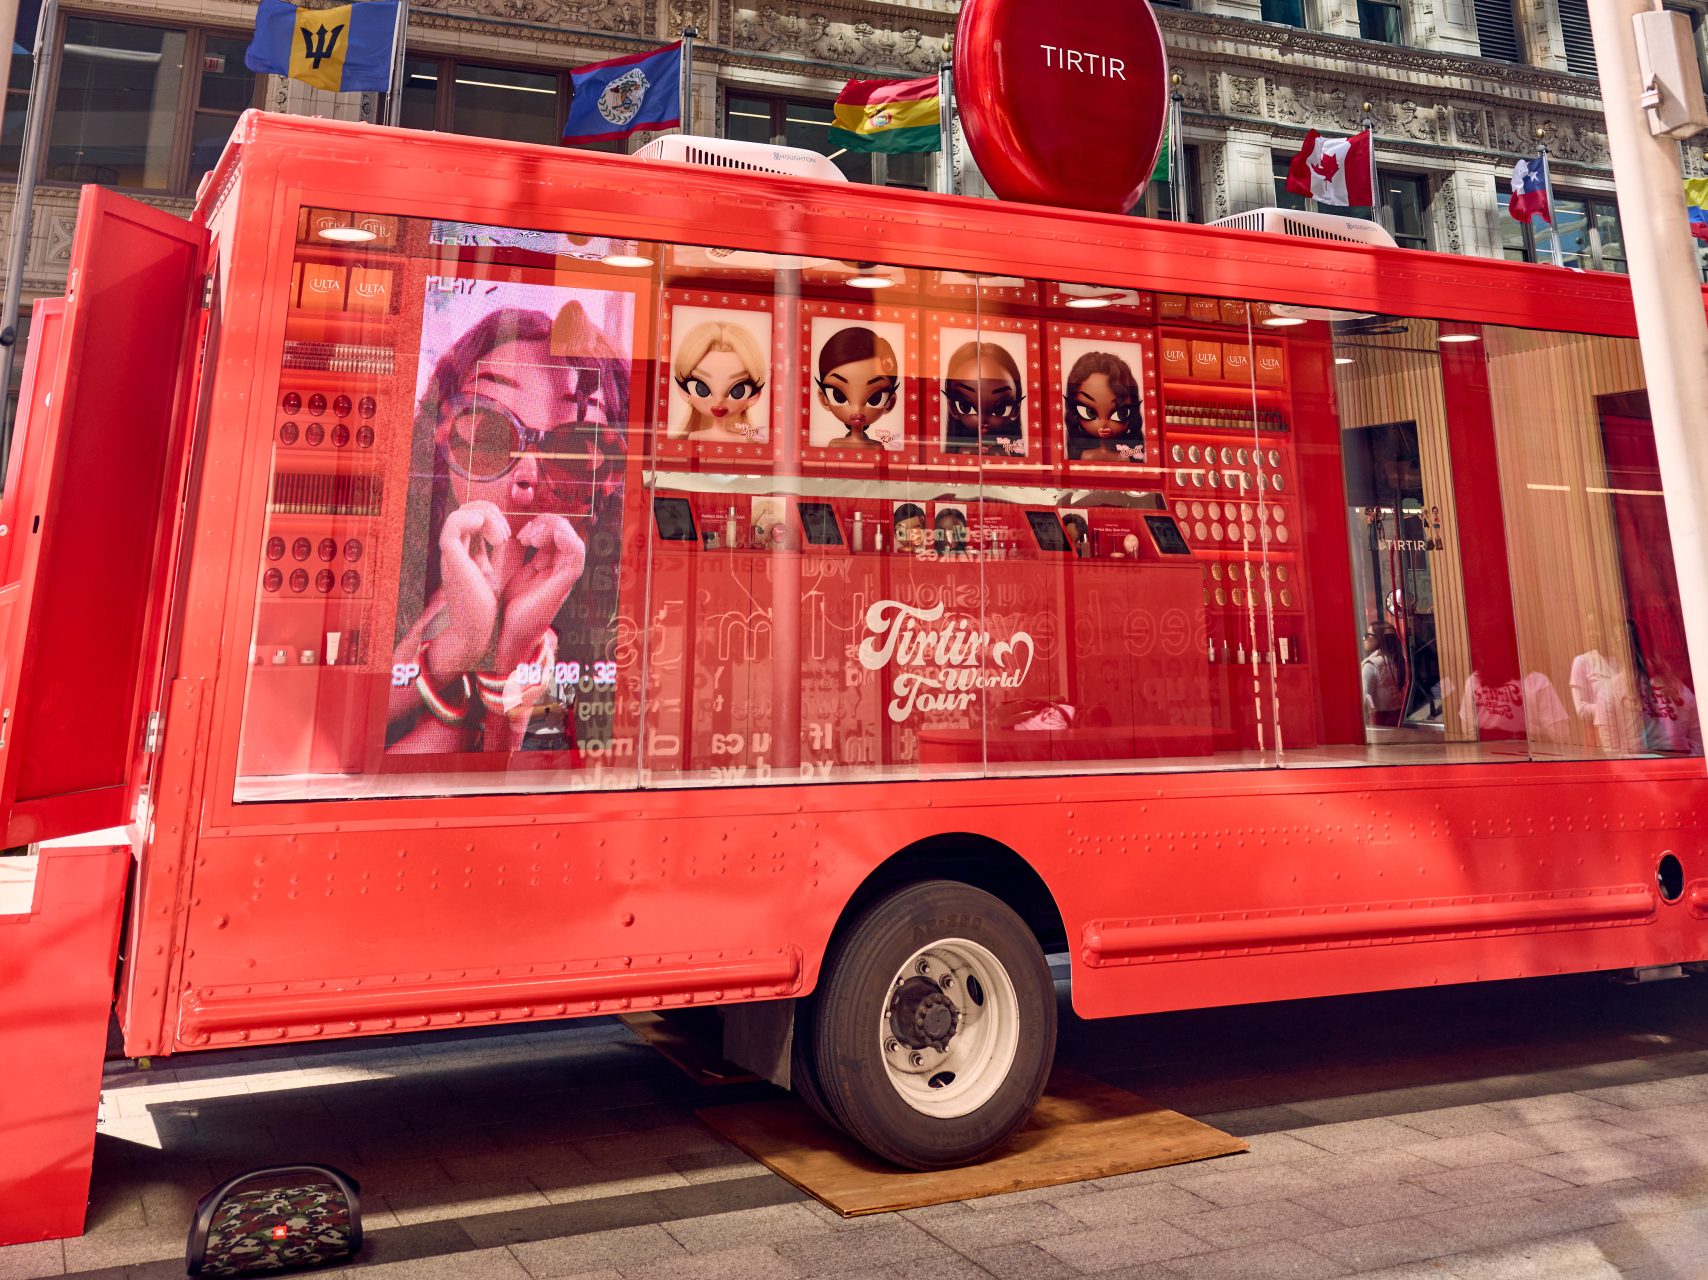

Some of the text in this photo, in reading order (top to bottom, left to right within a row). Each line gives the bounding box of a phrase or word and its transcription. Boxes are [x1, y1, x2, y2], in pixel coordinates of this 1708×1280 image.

[1040, 44, 1126, 81] TIRTIR
[780, 155, 816, 163] HOUGHTON
[314, 278, 341, 290] ULTA
[359, 282, 386, 294] ULTA
[1166, 350, 1185, 359] ULTA
[1198, 353, 1217, 362] ULTA
[1229, 355, 1248, 364] ULTA
[1262, 359, 1280, 367] ULTA
[1386, 540, 1426, 550] TIRTIR
[859, 600, 990, 670] Tirtir
[392, 663, 419, 686] SP
[516, 662, 617, 685] 0000:32
[939, 668, 1021, 693] World
[888, 673, 976, 723] Tour
